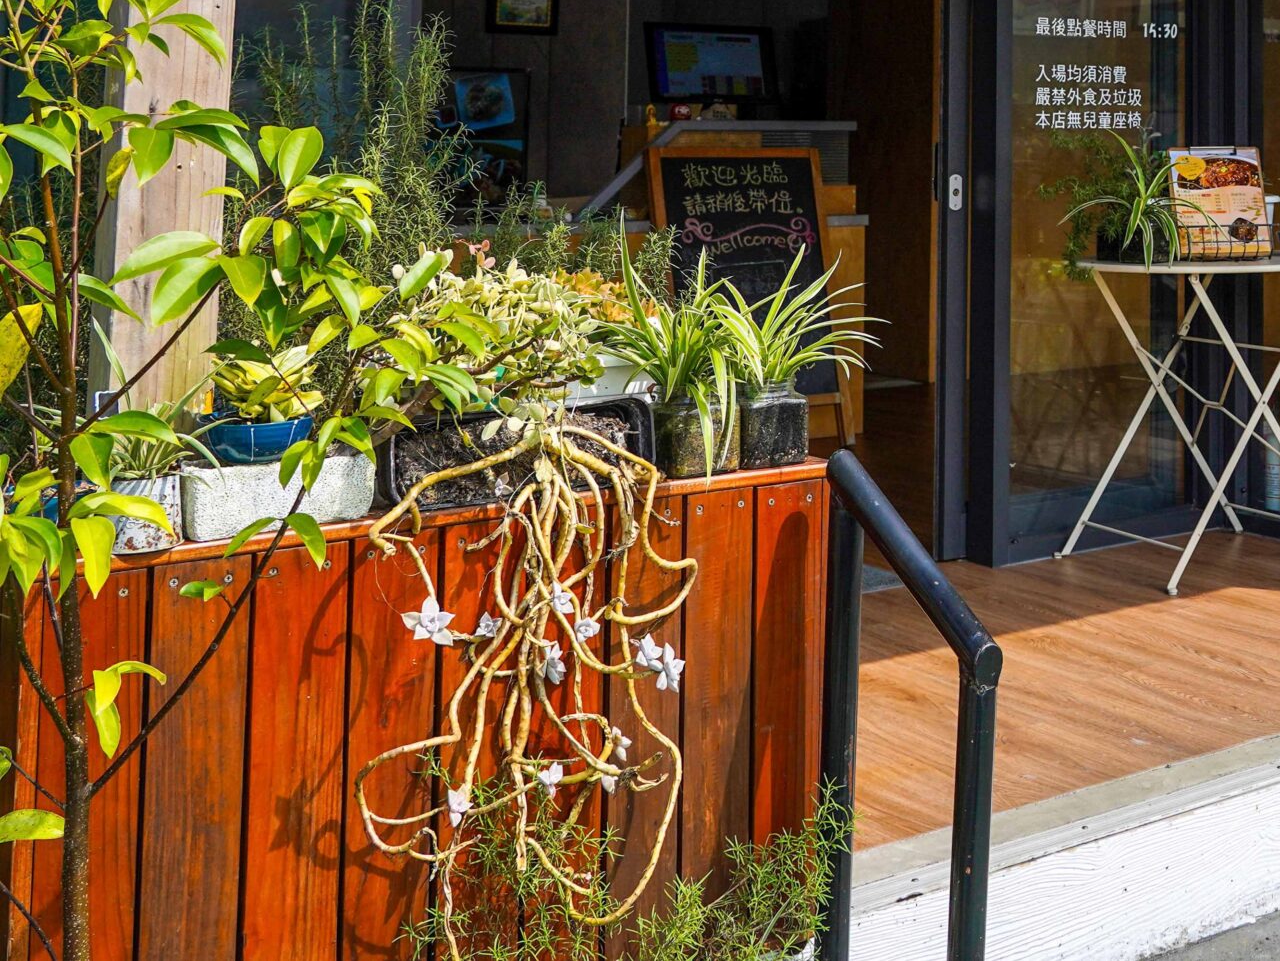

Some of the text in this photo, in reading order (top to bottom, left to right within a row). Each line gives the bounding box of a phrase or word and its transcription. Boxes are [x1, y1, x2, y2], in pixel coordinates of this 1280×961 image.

[1035, 17, 1178, 39] 最後點餐時間 15:30
[1035, 64, 1127, 84] 入場均須消費
[1035, 87, 1142, 107] 嚴禁外食及垃圾
[1035, 110, 1142, 129] 本店無兒童座椅
[681, 160, 789, 188] 歡迎光臨
